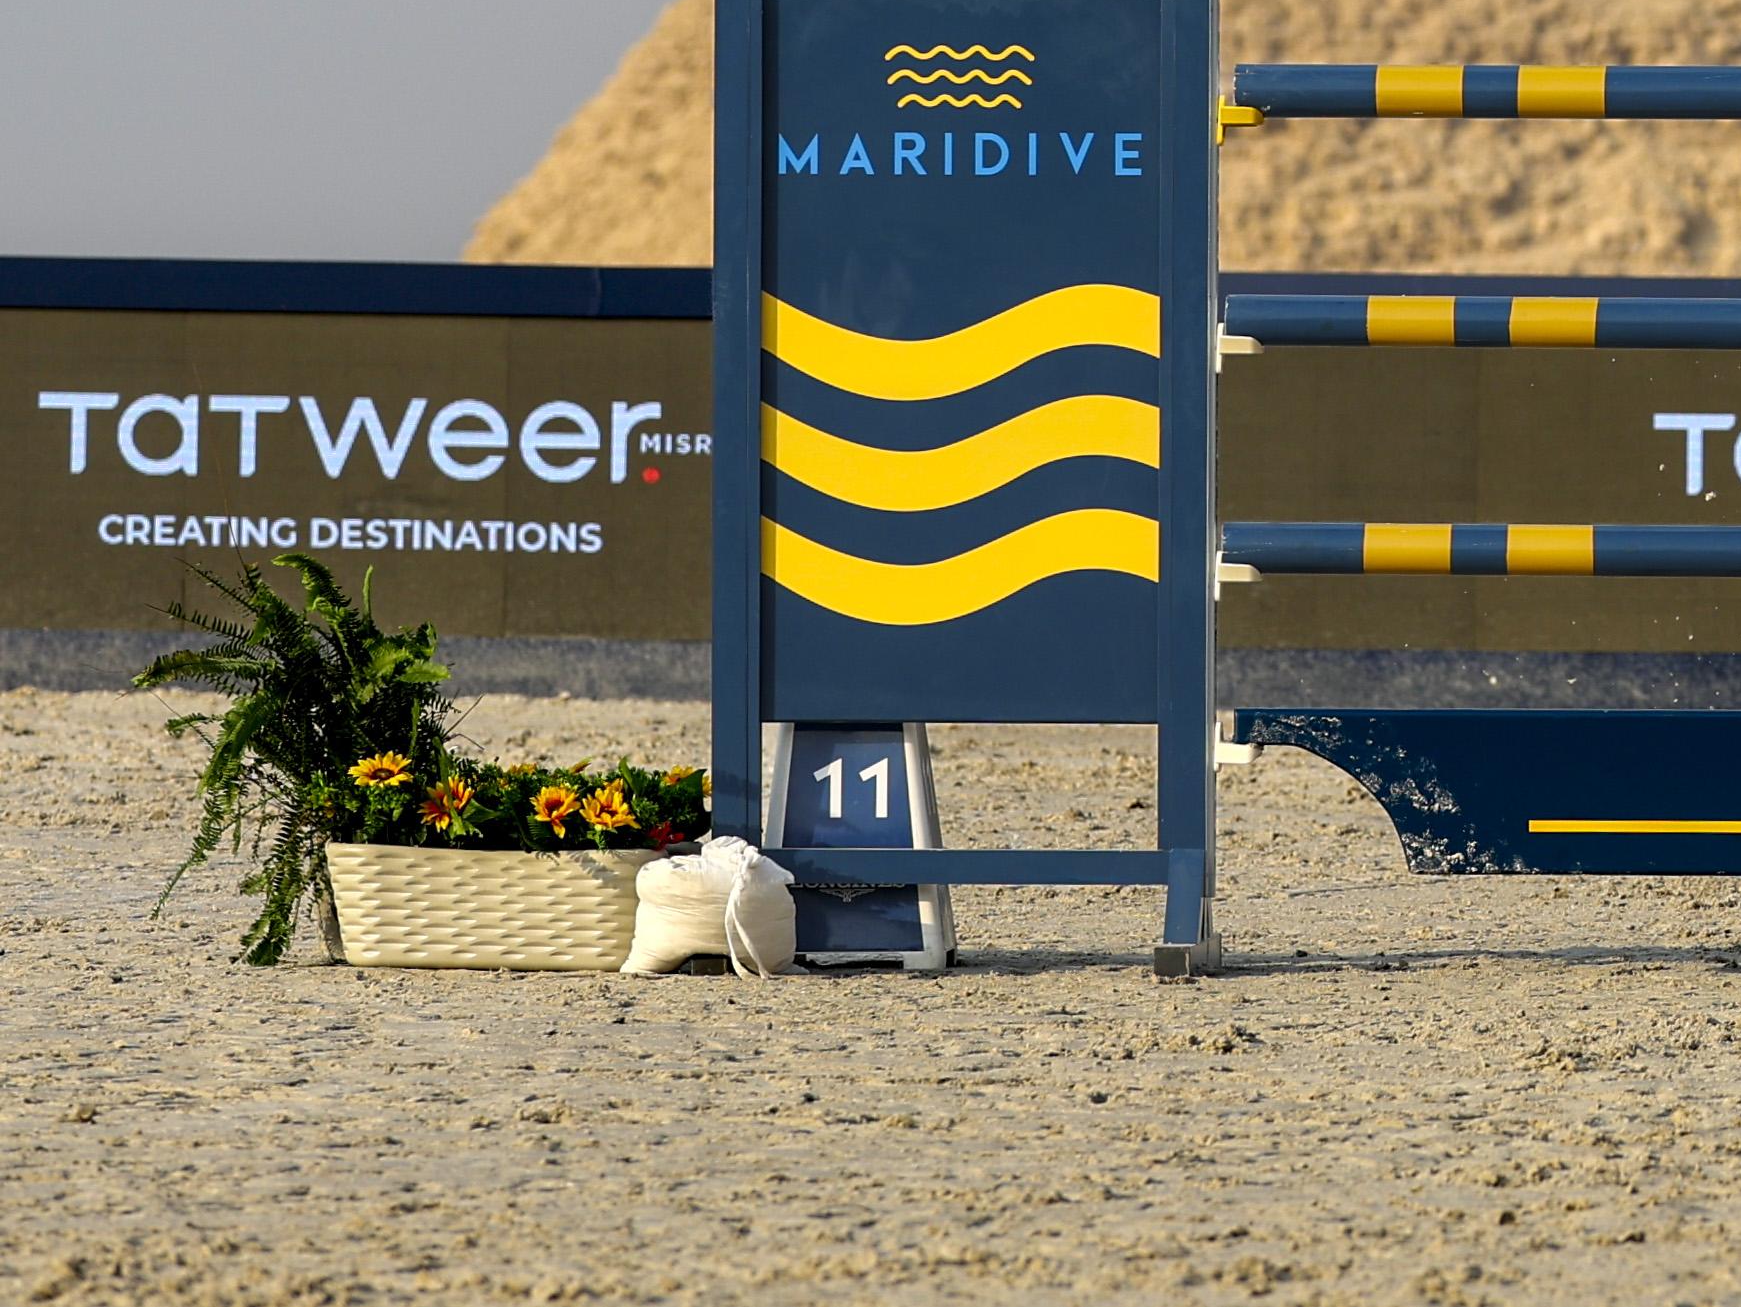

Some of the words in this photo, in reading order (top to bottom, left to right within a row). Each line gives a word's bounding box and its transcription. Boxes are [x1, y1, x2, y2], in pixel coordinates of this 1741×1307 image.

[778, 132, 1143, 176] MARIDIVE
[641, 432, 712, 456] MISR
[98, 513, 297, 548] CREATING
[310, 517, 603, 553] DESTINATIONS
[813, 757, 889, 819] 11
